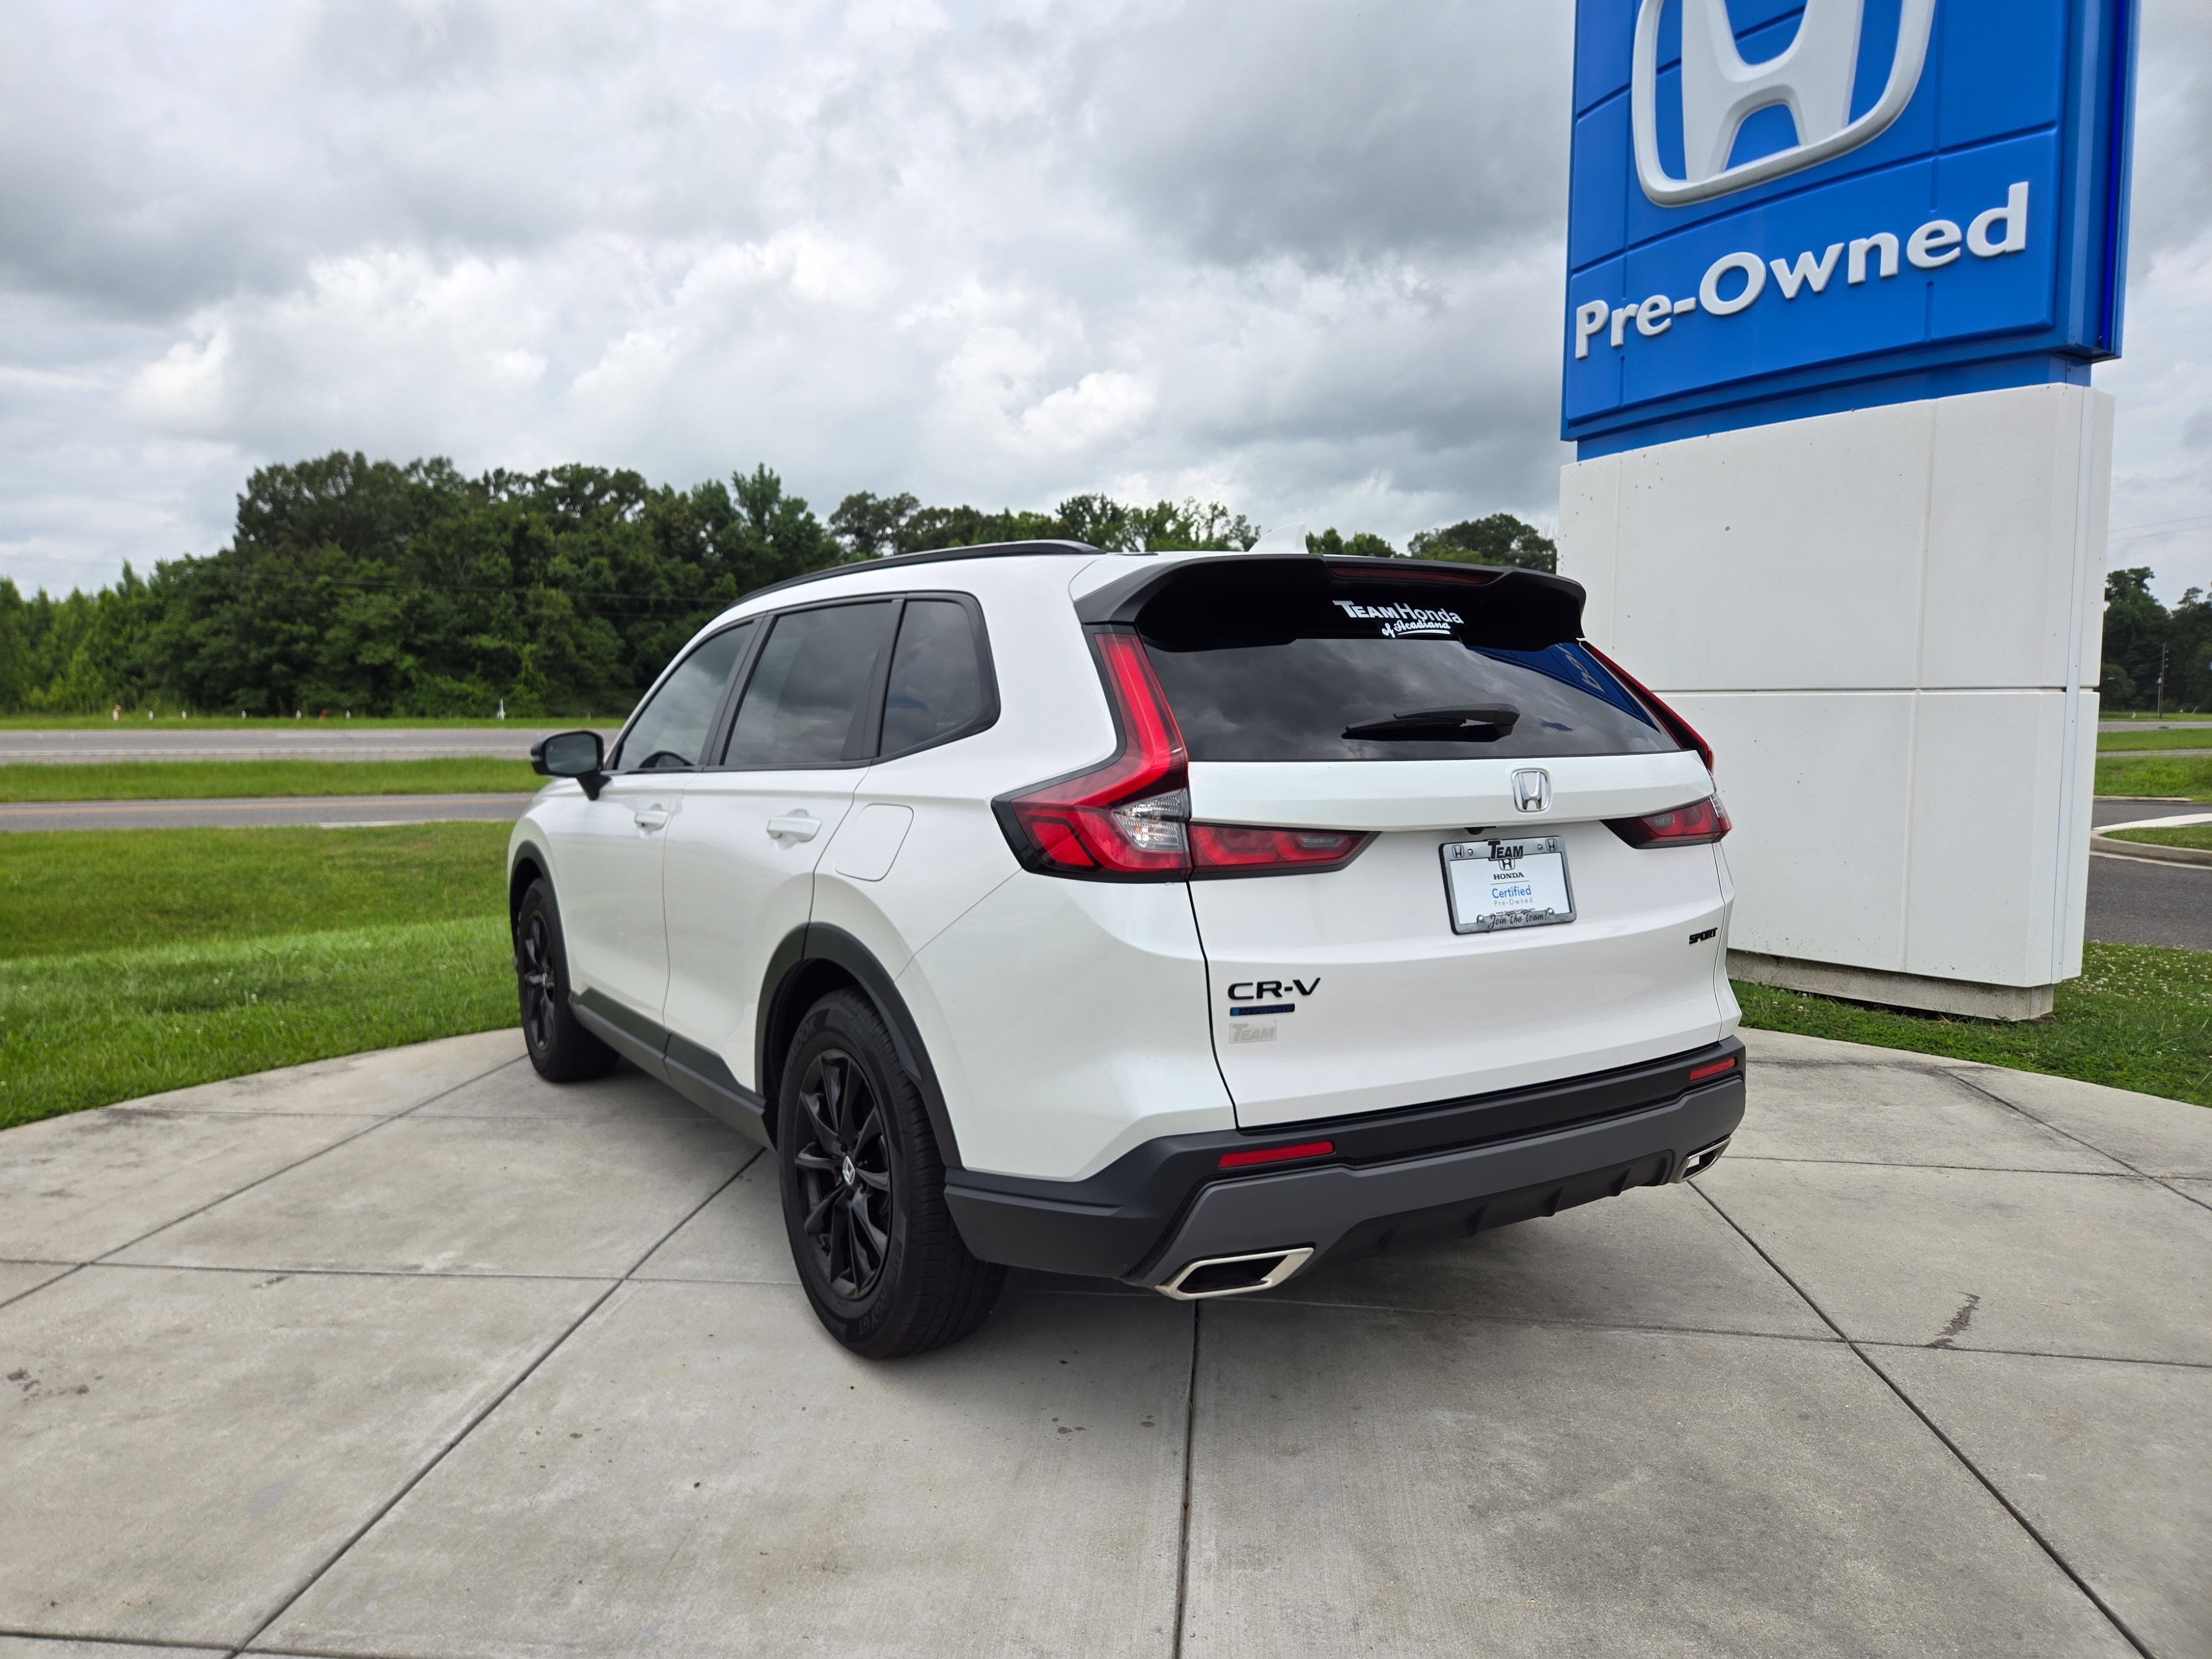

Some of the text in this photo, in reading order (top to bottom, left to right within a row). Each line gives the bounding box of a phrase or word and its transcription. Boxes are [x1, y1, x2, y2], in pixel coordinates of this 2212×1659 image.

[1575, 181, 2029, 361] Pre-Owned
[1394, 602, 1464, 624] Honda
[1382, 619, 1451, 638] of Acadiana
[1492, 885, 1531, 899] Certified
[1494, 898, 1533, 906] Pre-Owned
[1488, 914, 1507, 930] Join
[1689, 927, 1718, 944] SPORT
[1228, 977, 1321, 1000] CR-V
[1240, 1006, 1291, 1015] HYBRID
